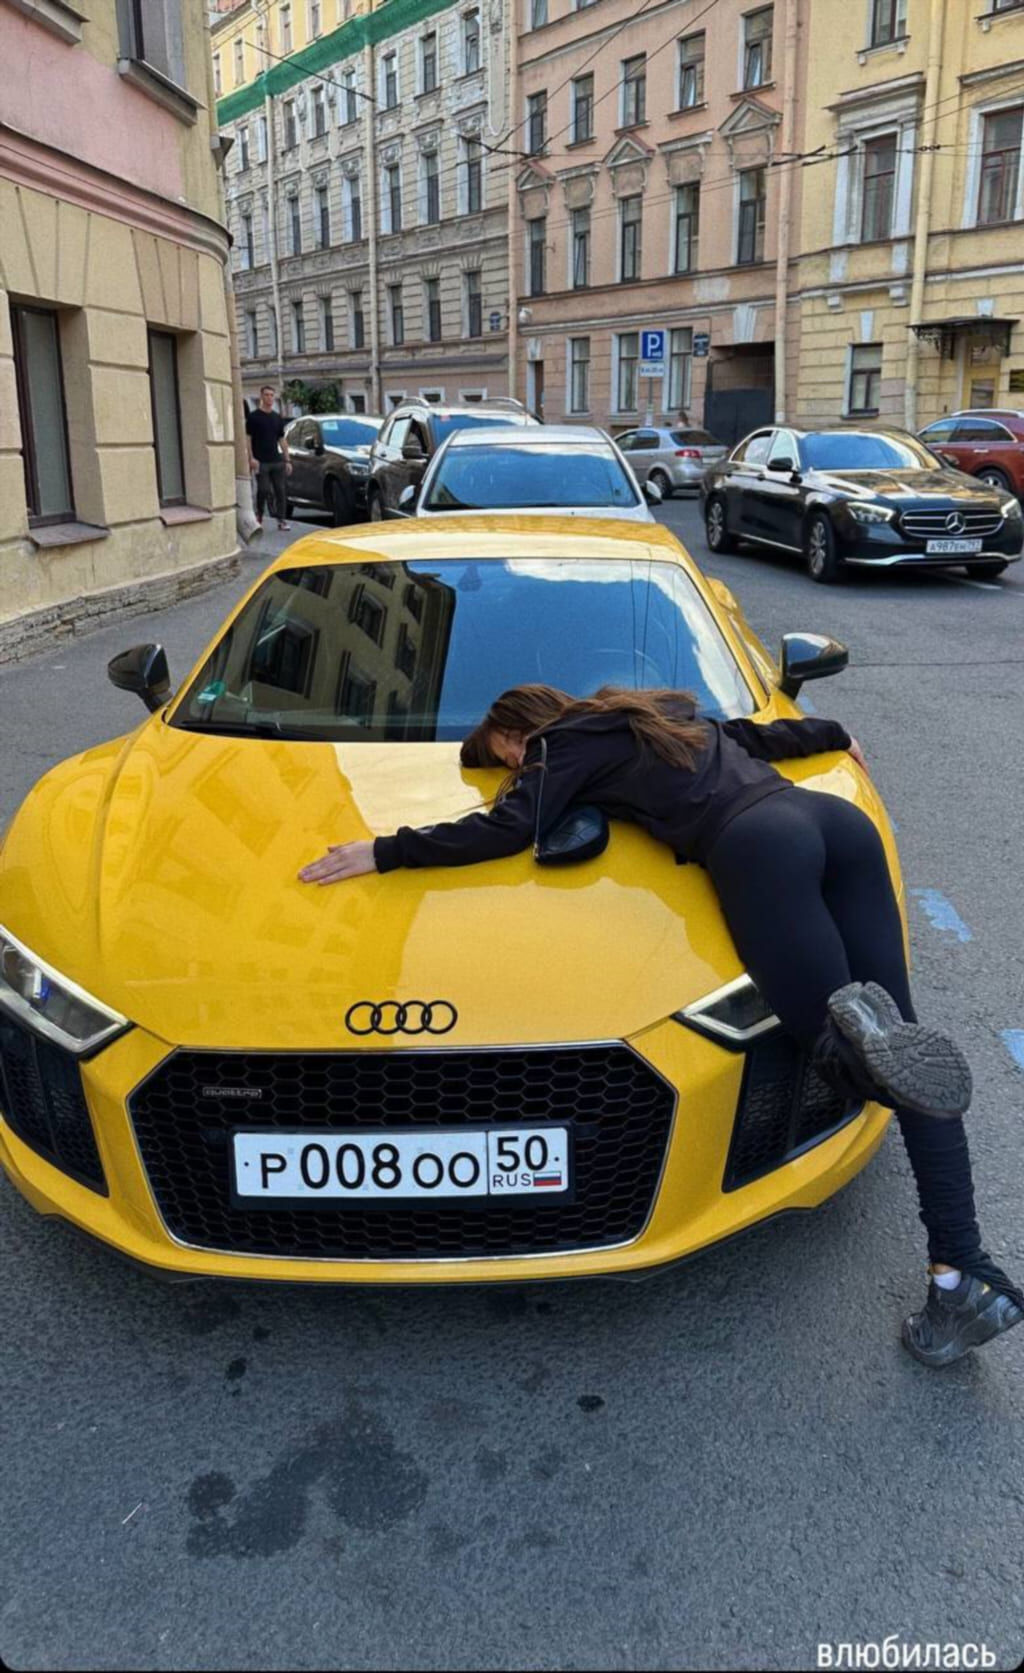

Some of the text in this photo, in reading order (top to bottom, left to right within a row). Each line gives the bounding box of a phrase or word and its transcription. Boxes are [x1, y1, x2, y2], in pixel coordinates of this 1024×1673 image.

[647, 334, 661, 357] P
[496, 1135, 548, 1171] 50
[492, 1173, 532, 1187] RUS
